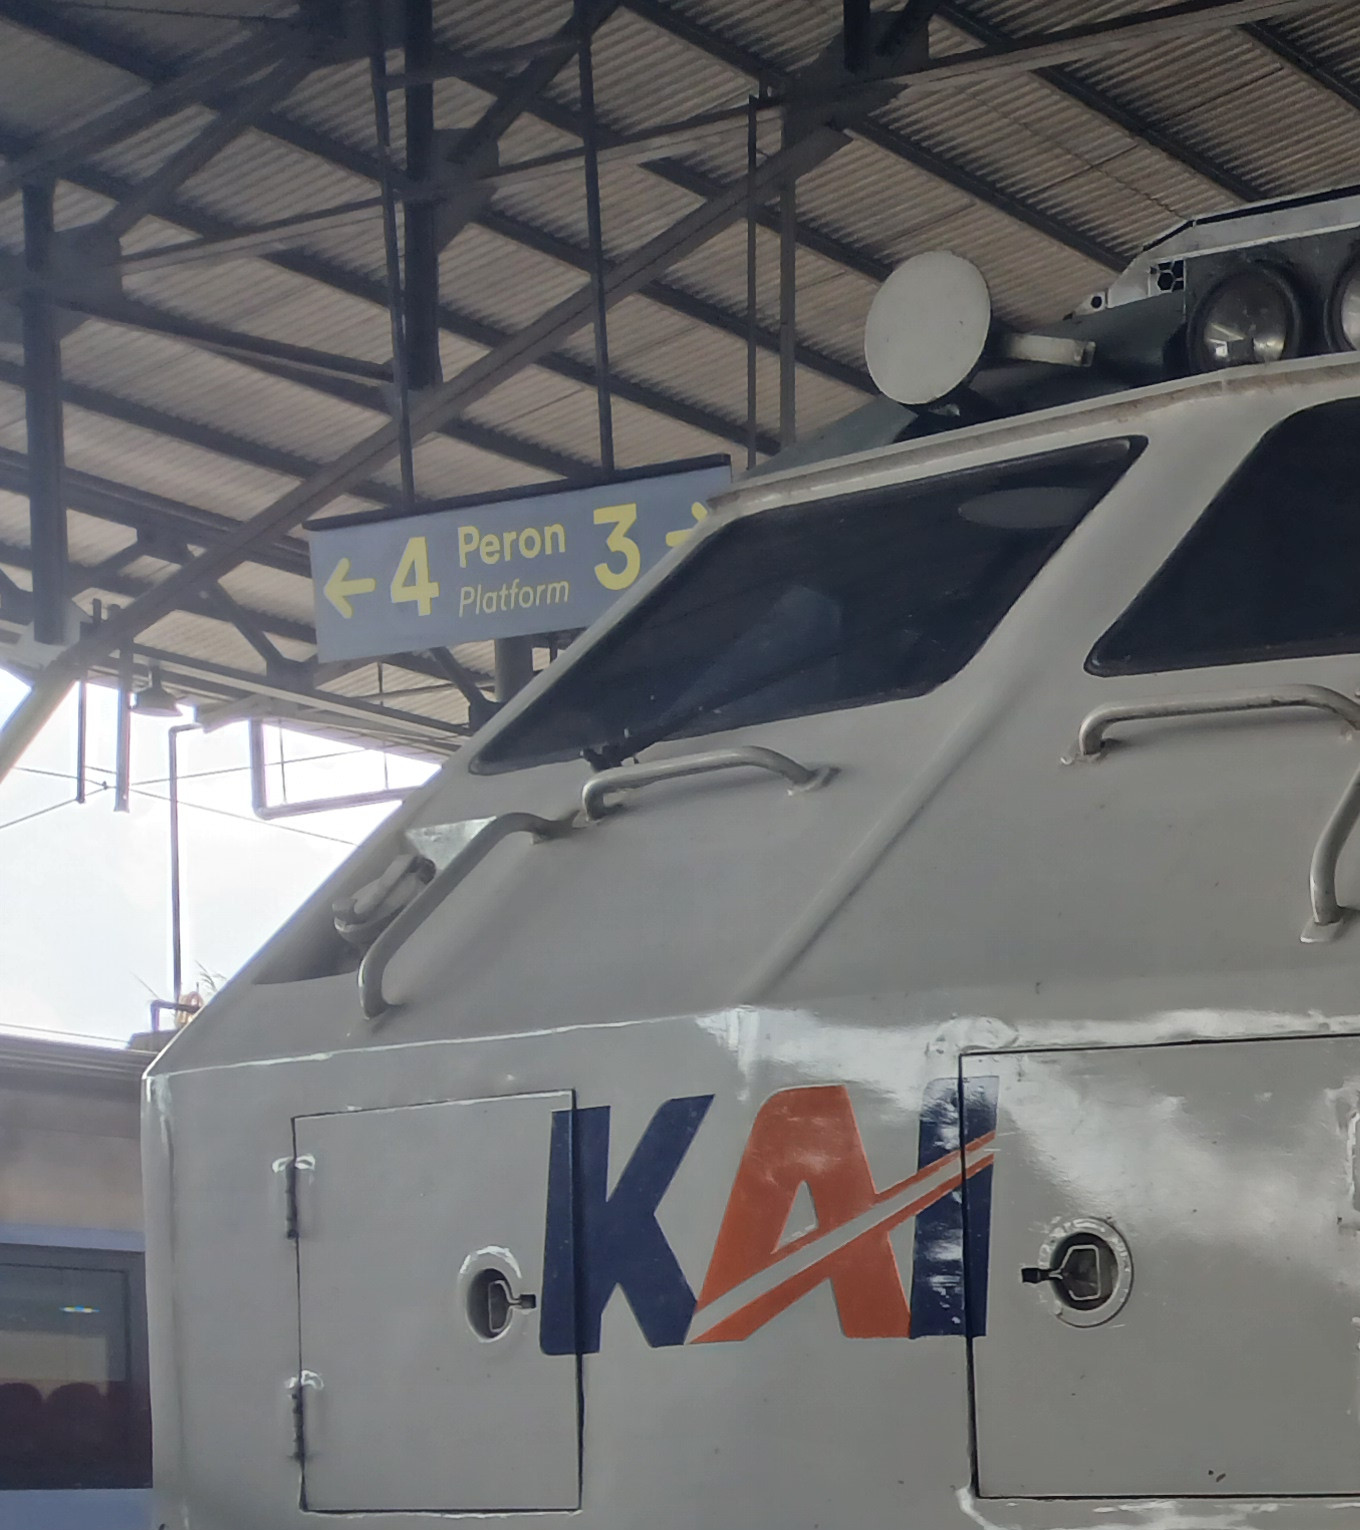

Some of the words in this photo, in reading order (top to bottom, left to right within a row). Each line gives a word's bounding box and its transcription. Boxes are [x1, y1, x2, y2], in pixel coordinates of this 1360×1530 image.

[390, 536, 440, 618] 4
[457, 522, 567, 569] Peron
[592, 502, 641, 592] 3
[457, 578, 570, 619] Platform
[540, 1075, 999, 1356] KAI
